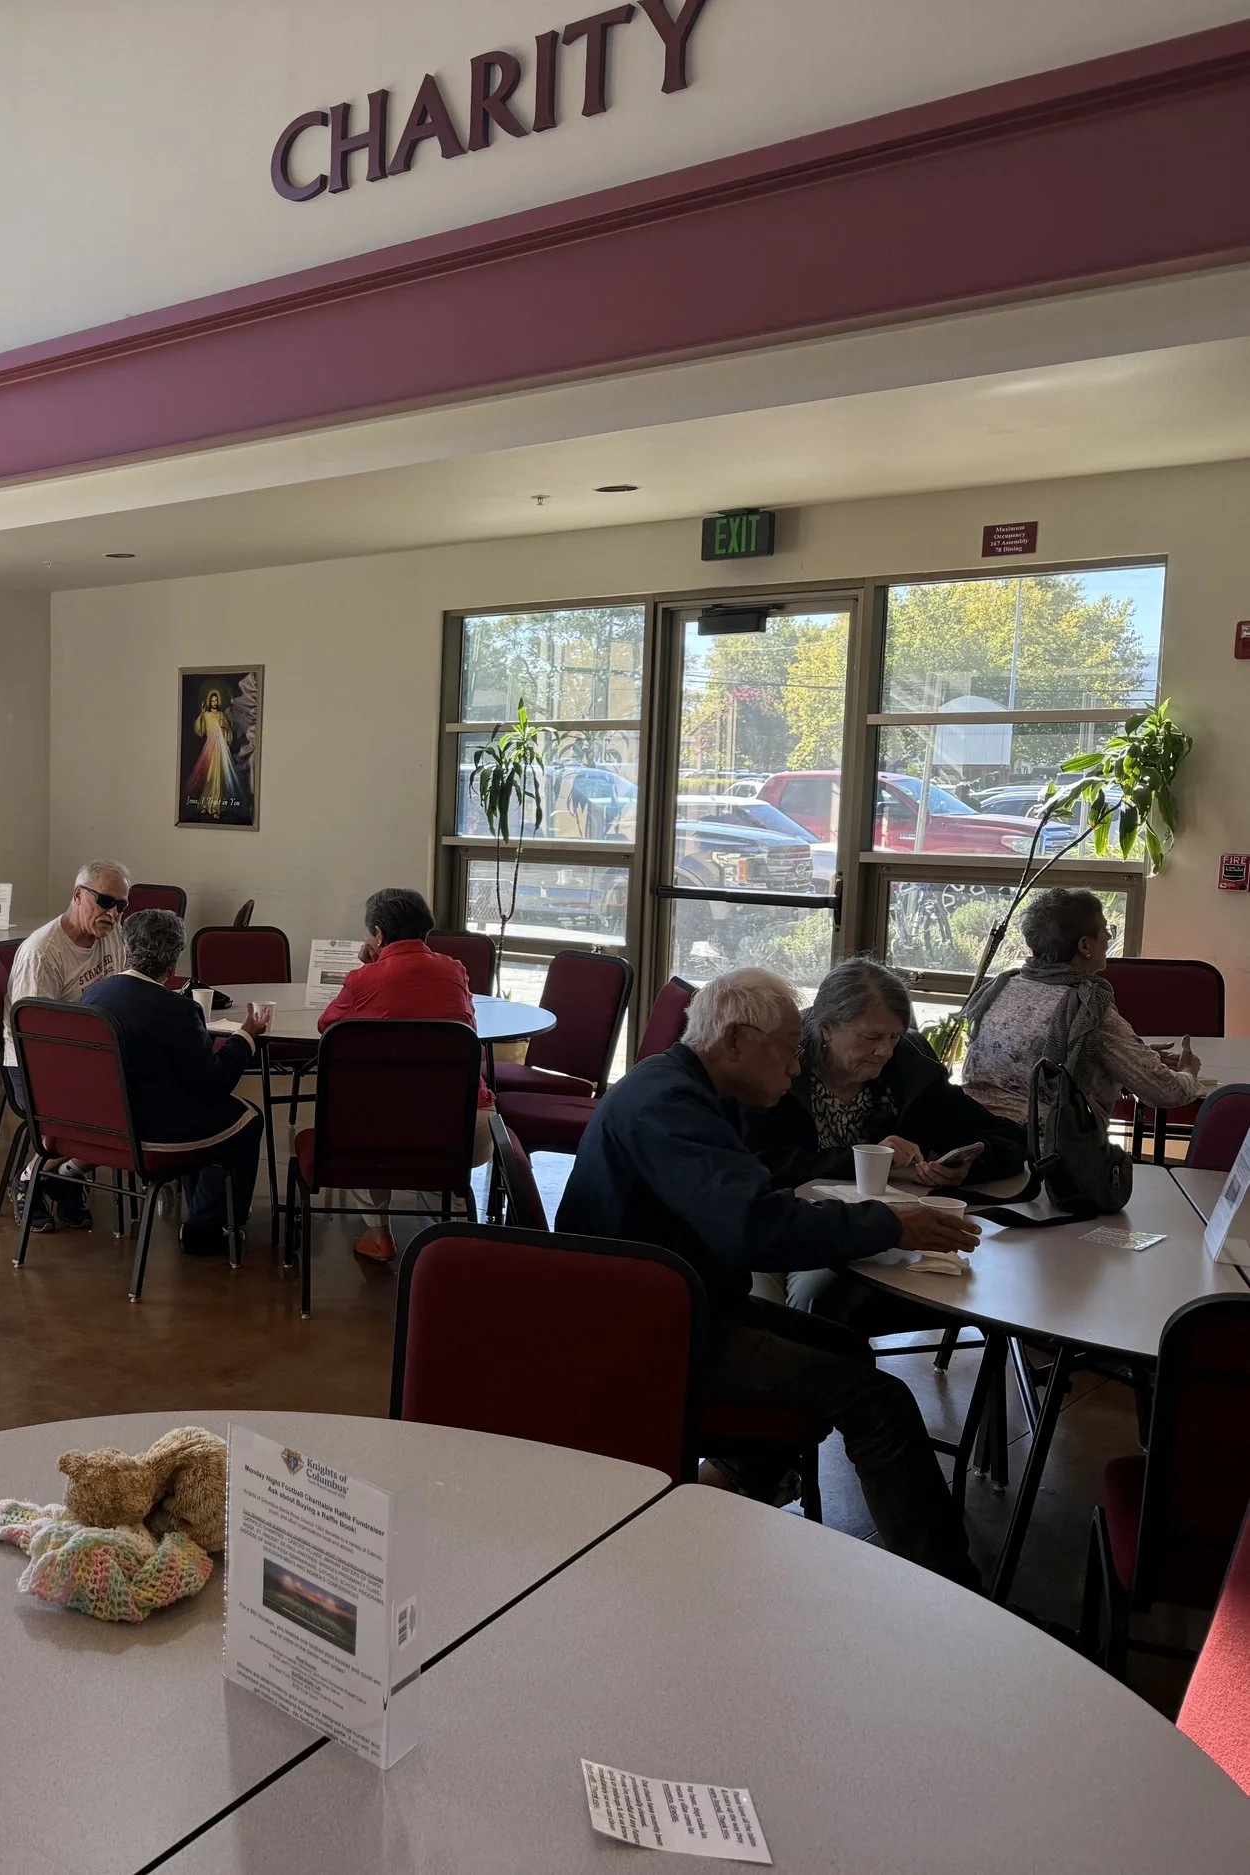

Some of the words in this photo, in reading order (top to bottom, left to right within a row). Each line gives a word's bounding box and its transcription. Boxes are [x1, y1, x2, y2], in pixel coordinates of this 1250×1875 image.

[270, 0, 708, 202] CHARITY
[714, 514, 760, 555] EXIT
[230, 798, 240, 806] You
[307, 1458, 337, 1481] Knights
[339, 1473, 347, 1483] of
[244, 1464, 264, 1480] Monday
[265, 1474, 280, 1487] Night
[281, 1482, 303, 1497] Football
[304, 1494, 332, 1512] Charitable
[334, 1508, 351, 1520] Raffle
[352, 1516, 384, 1536] Fundraiser
[267, 1486, 278, 1495] Ask
[280, 1492, 294, 1504] about
[296, 1500, 315, 1515] Buying
[321, 1512, 337, 1524] Raffle
